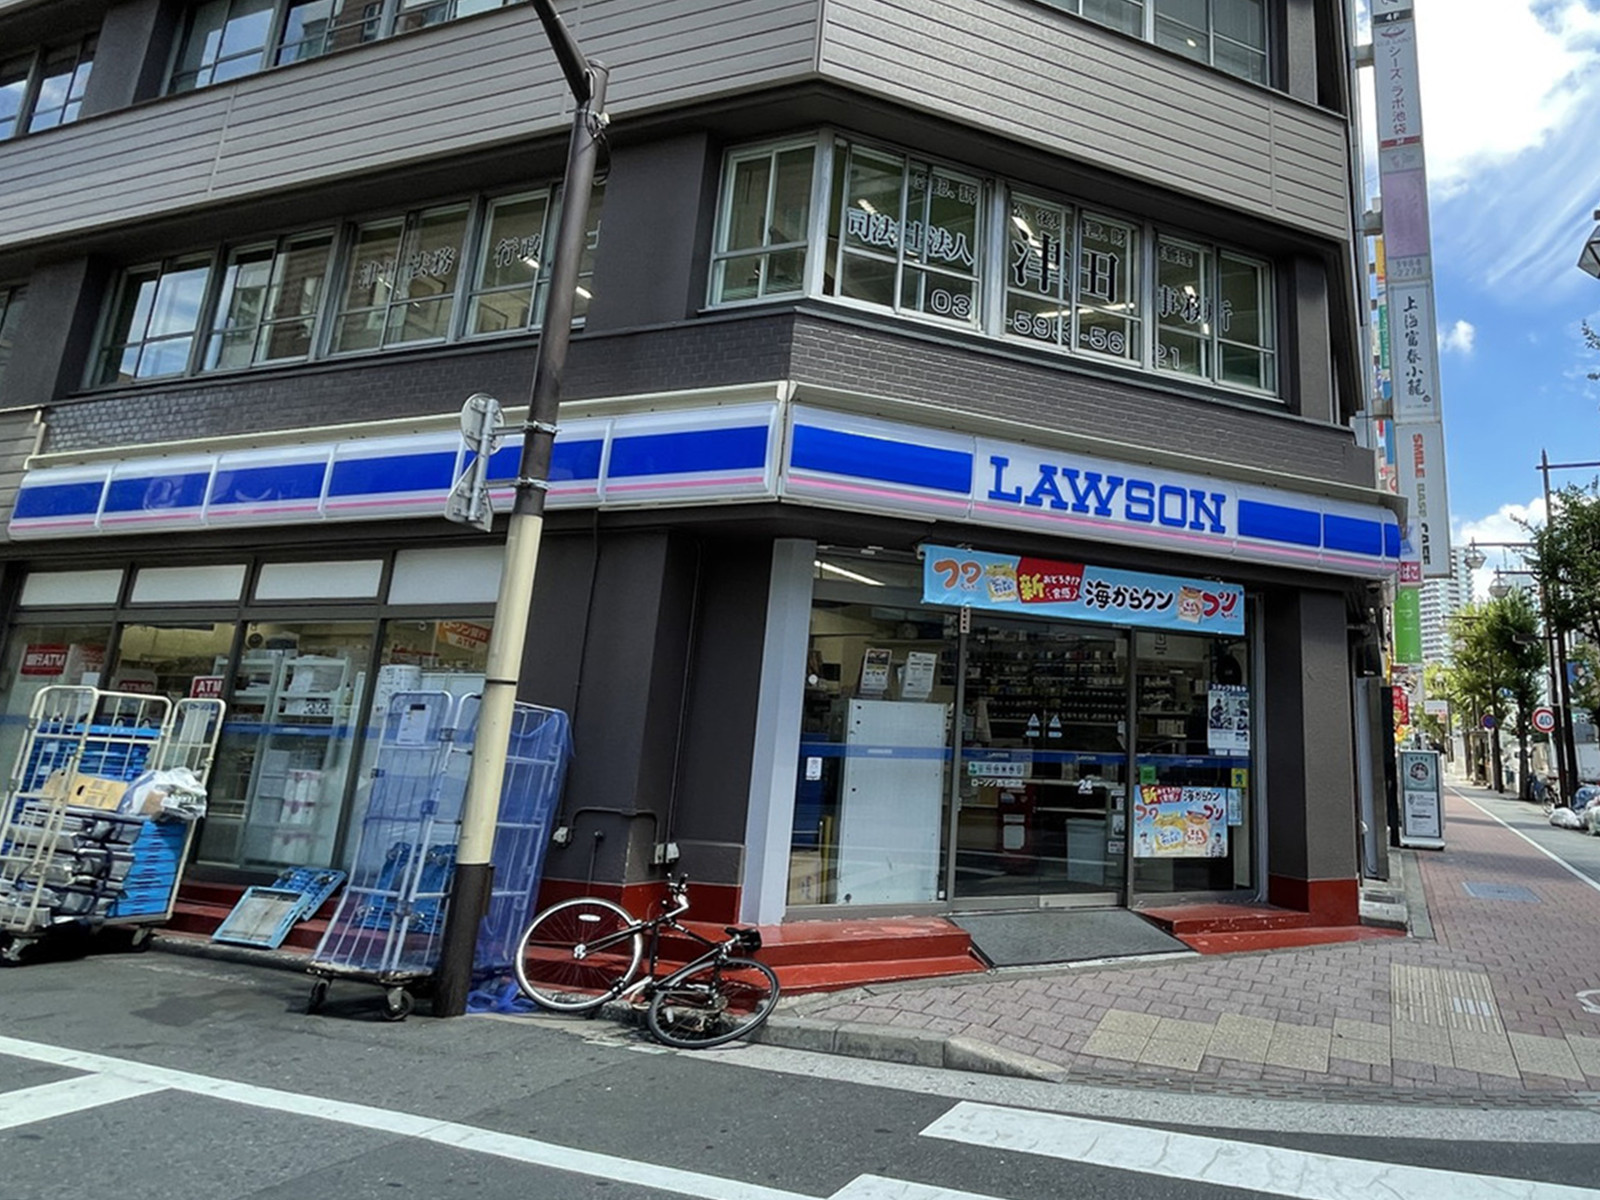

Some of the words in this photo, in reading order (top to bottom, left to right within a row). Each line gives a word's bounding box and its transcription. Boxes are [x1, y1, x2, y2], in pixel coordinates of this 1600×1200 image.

[1385, 11, 1400, 21] 4F
[846, 207, 976, 267] 司法士法人
[1012, 230, 1120, 304] 津田
[1412, 433, 1426, 479] SMILE
[987, 456, 1227, 534] LAWSON
[1019, 573, 1045, 601] 新
[1084, 578, 1175, 611] 海からクン
[197, 680, 223, 692] ATM
[1538, 714, 1553, 726] 40
[1078, 779, 1094, 790] 24
